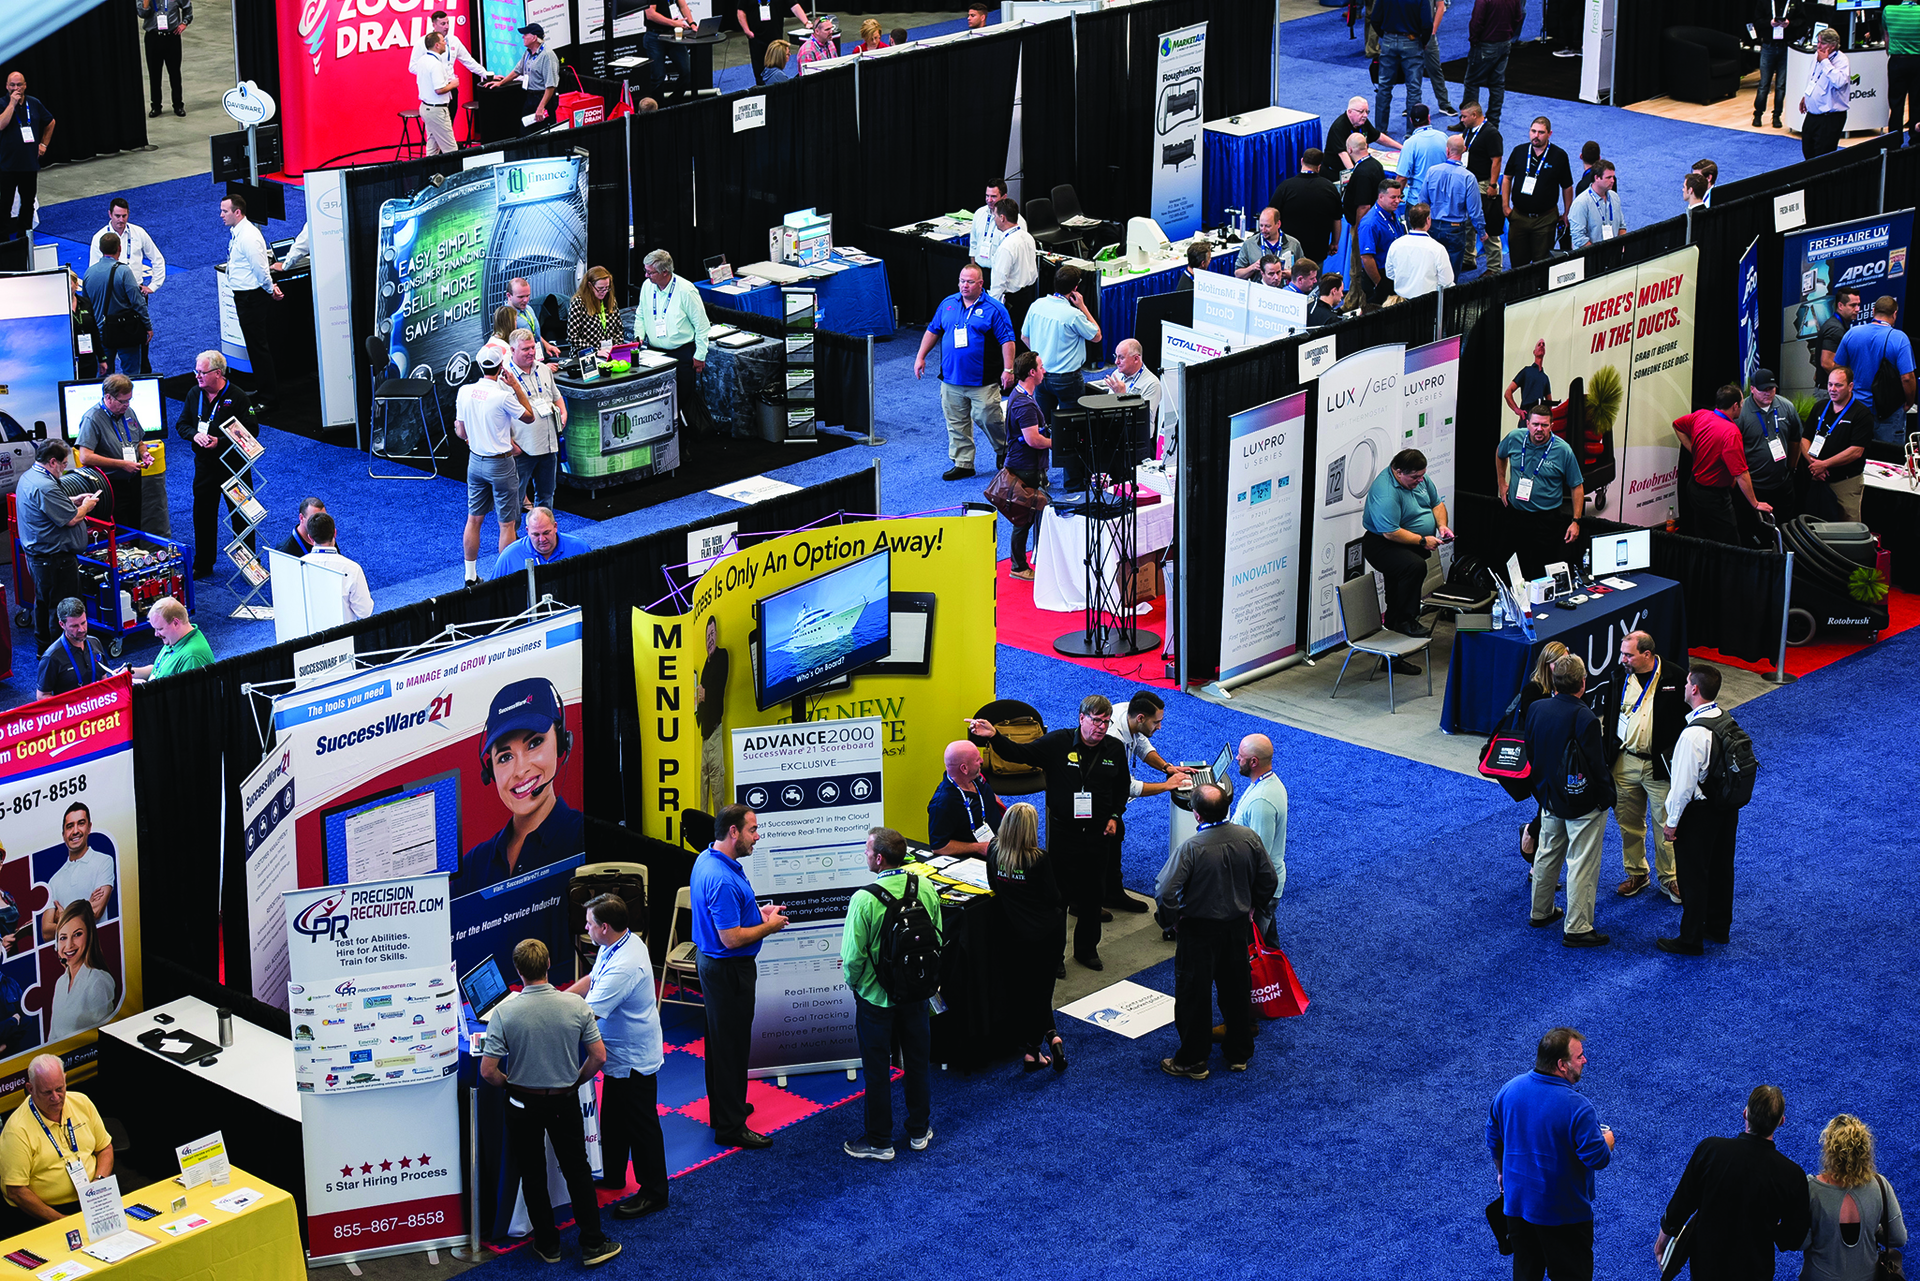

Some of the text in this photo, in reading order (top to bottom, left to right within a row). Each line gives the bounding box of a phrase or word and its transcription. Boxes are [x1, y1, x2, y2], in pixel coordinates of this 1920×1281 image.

[226, 100, 262, 114] DAVISWARE
[1810, 226, 1888, 251] FRESH-AIRE UV
[1833, 245, 1865, 257] DISINFECTION
[1867, 240, 1887, 249] SYSTEMS
[398, 226, 483, 278] EASY, SIMPLE
[397, 247, 486, 294] CONSUMER FINANCING
[1839, 260, 1886, 282] APCO
[402, 271, 477, 318] SELL MORE
[1582, 274, 1683, 326] THERE'S MONEY
[405, 296, 480, 343] SAVE MORE
[1590, 306, 1680, 354] IN THE DUCTS.
[1167, 335, 1221, 357] TOTALTECH
[1635, 340, 1678, 363] GRAB BEFORE
[1634, 353, 1690, 380] SOMEONE ELSE DOES.
[1404, 374, 1445, 397] LUXPRO
[612, 389, 652, 404] SIMPLE CONSUMER
[1414, 391, 1442, 406] SERIES
[1350, 406, 1388, 424] THERMOSTAT
[1243, 433, 1285, 458] LUXPRO
[1254, 450, 1282, 467] SERIES
[1628, 466, 1678, 495] Rotobrush
[1236, 515, 1284, 536] programmable universal
[702, 535, 723, 548] THE NEW
[1235, 531, 1258, 544] thermostats
[701, 546, 712, 558] FLAT
[714, 527, 944, 600] Is Only An Option Away!
[1232, 556, 1288, 587] INNOVATIVE
[1318, 569, 1336, 581] Geofencing
[1236, 578, 1280, 599] Intuitive functionality
[1231, 589, 1285, 615] Consumer recommended
[1234, 598, 1281, 620] Best touchscreen
[1262, 605, 1279, 617] running
[1250, 615, 1286, 633] battery-powered
[1320, 611, 1333, 621] Enabled
[1827, 616, 1870, 626] Rotobrush
[1251, 626, 1275, 639] thermostat
[396, 639, 542, 691] to MANAGE and GROW your business
[796, 670, 813, 682] Who's
[825, 656, 844, 670] Board?
[653, 624, 682, 742] MENU
[308, 685, 384, 717] The tools you need
[498, 699, 526, 715] SuccessWare
[836, 697, 905, 720] NEW
[7, 692, 118, 737] take your business
[316, 693, 453, 755] SuccessWare 21
[16, 730, 57, 760] Good
[60, 728, 76, 746] to
[80, 711, 120, 738] Great
[744, 727, 874, 751] ADVANCE2000
[743, 741, 874, 760] SuccessWare Scoreboard
[780, 759, 837, 771] EXCLUSIVE
[246, 764, 281, 812] SuccessWare
[658, 759, 680, 840] PRI
[834, 814, 846, 822] the
[848, 812, 870, 820] Cloud
[767, 823, 871, 838] Retrieve Real-Time Reporting!
[506, 868, 550, 889] SuccessWare21.com
[351, 886, 414, 906] PRECISION
[781, 897, 819, 907] Access the
[350, 897, 444, 921] RECRUITER.COM
[456, 896, 561, 940] for the Home Service Industry
[799, 907, 812, 916] any
[335, 932, 410, 948] Test for Abilities.
[336, 942, 410, 957] Hire for Attitude.
[340, 958, 362, 967] Train
[380, 953, 408, 962] Skills.
[381, 982, 416, 990] RECRUITER.COM
[784, 984, 847, 996] Real-Time KPI
[1251, 982, 1280, 997] ZOOM
[792, 998, 843, 1009] Drill Downs
[1250, 991, 1281, 1004] DRAIN
[784, 1011, 849, 1023] Goal Tracking
[762, 1027, 808, 1039] Employee
[778, 1041, 798, 1050] And
[801, 1038, 827, 1048] Much
[326, 1168, 448, 1192] 5 Star Hiring Process
[333, 1210, 444, 1239] 855-867-8558
